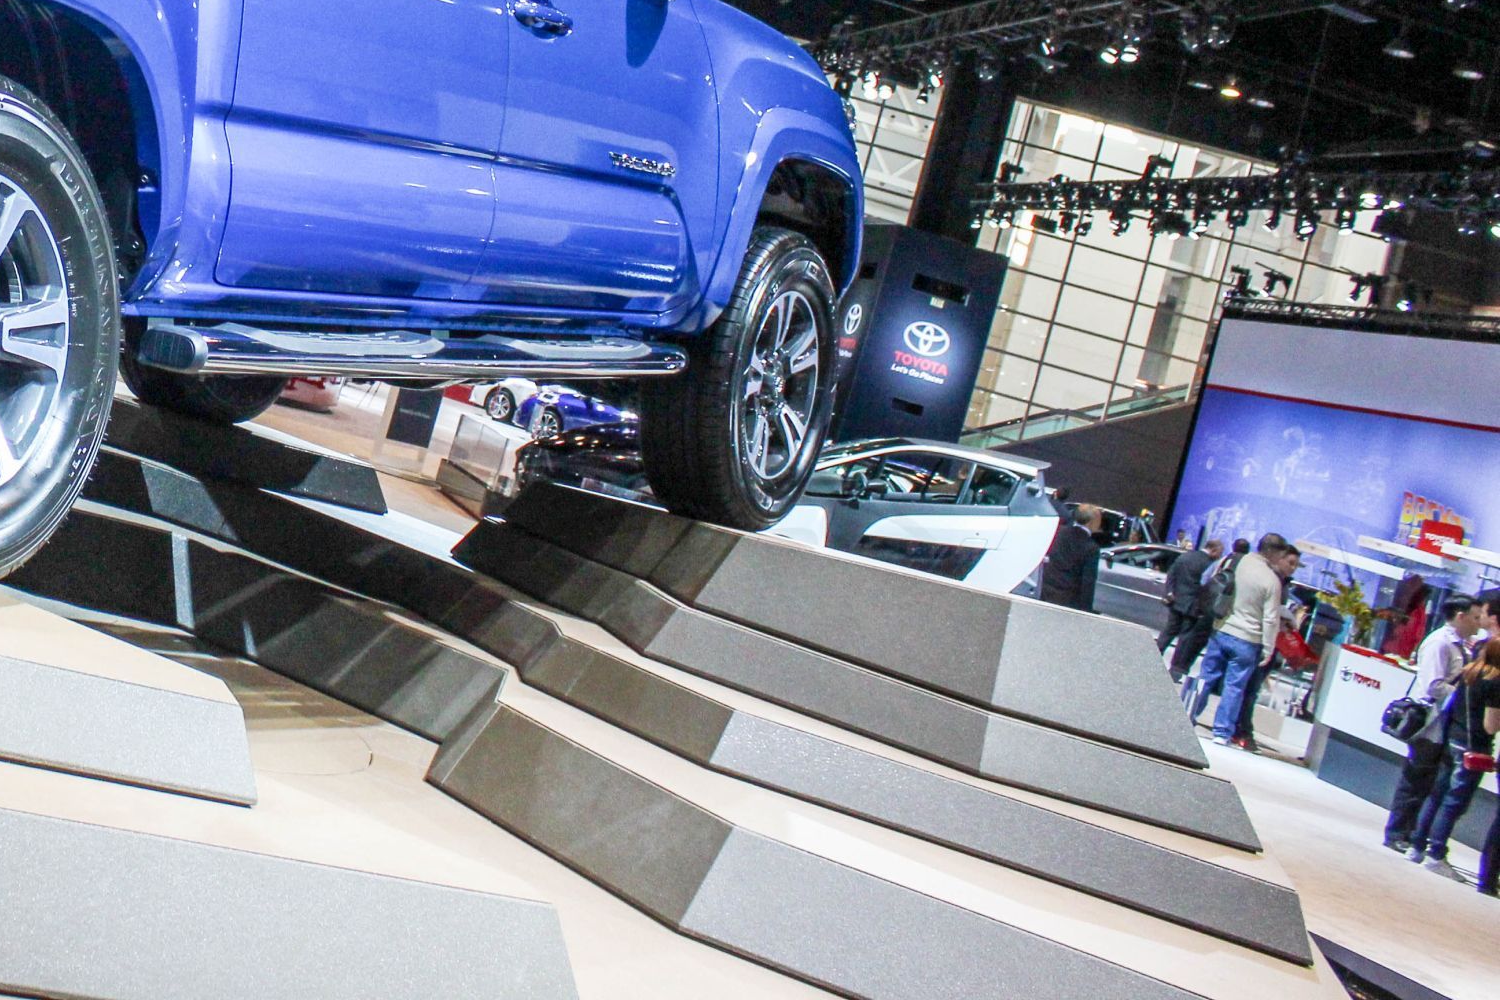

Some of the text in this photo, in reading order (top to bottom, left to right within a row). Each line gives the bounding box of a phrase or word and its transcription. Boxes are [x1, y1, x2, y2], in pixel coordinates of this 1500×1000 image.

[891, 363, 944, 385] Let's Go Places
[894, 351, 948, 376] TOYOTA
[1353, 672, 1381, 690] TOYOTA
